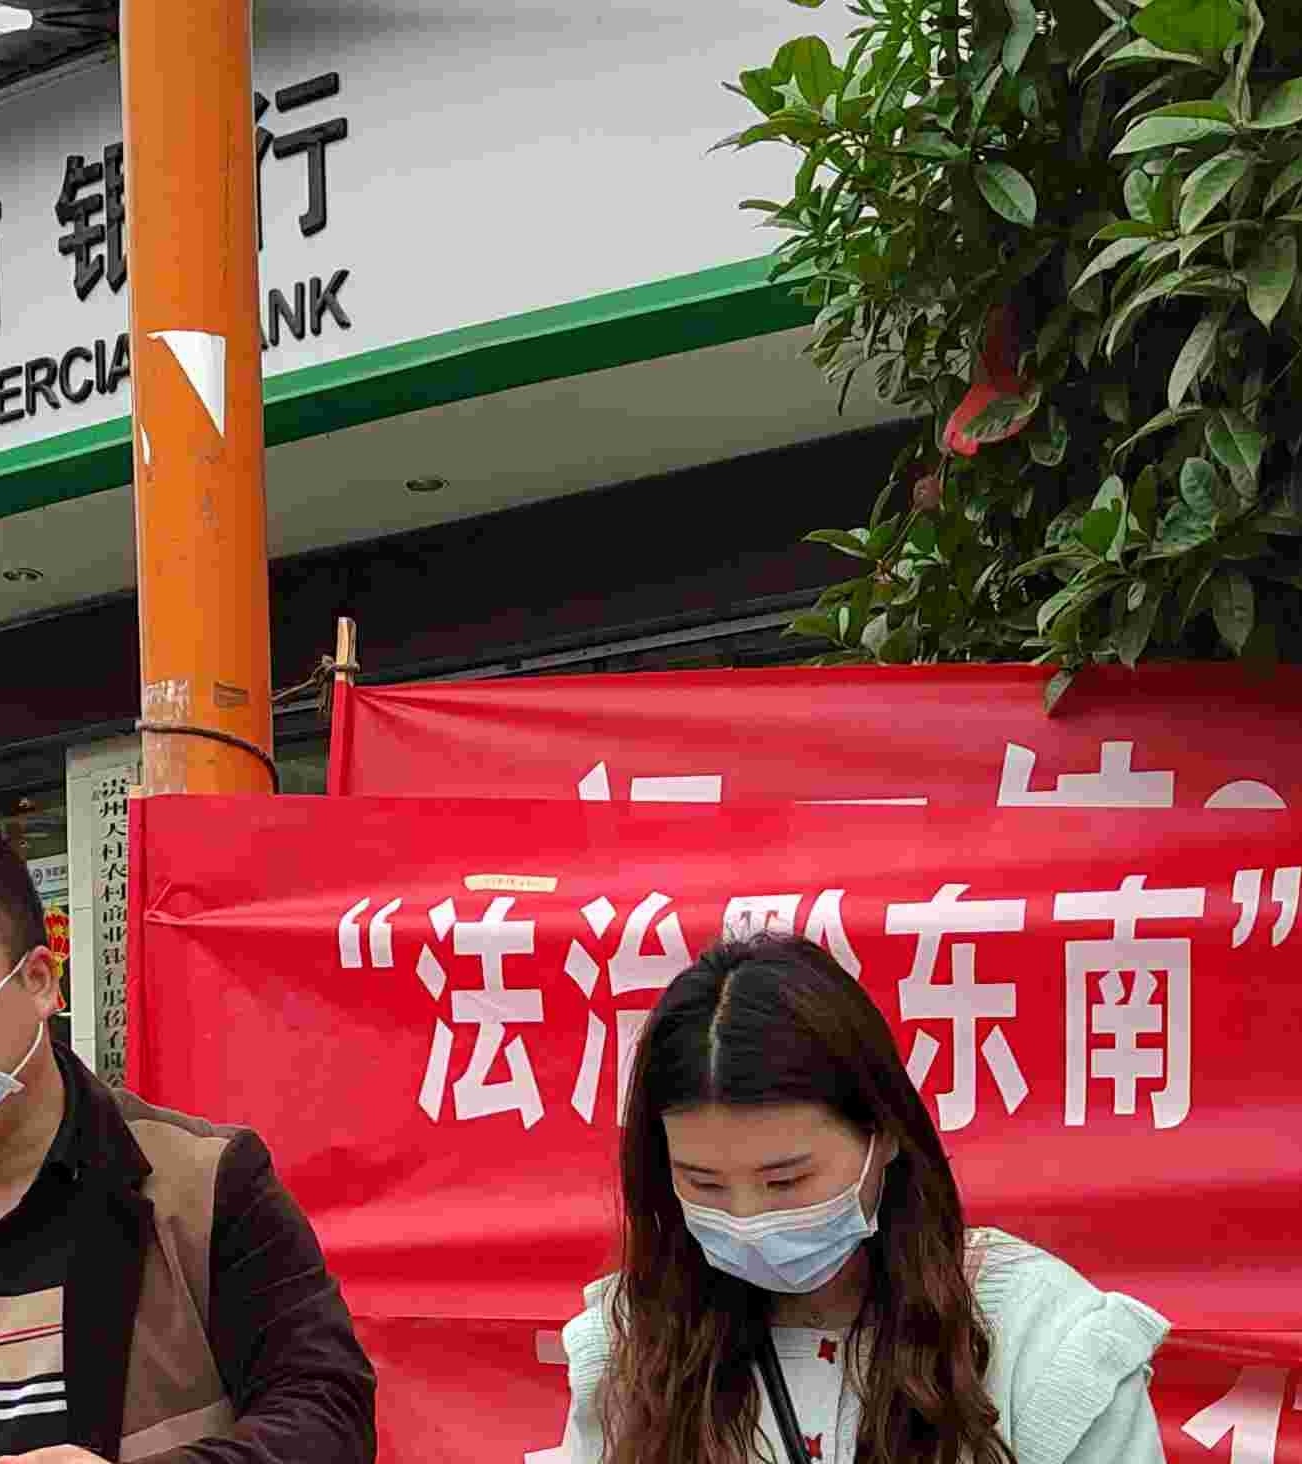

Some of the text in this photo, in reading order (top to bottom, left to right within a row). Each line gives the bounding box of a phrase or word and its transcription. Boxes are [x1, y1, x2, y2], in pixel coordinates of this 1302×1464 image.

[260, 269, 352, 350] NK
[337, 865, 1302, 1132] “法治东南”
